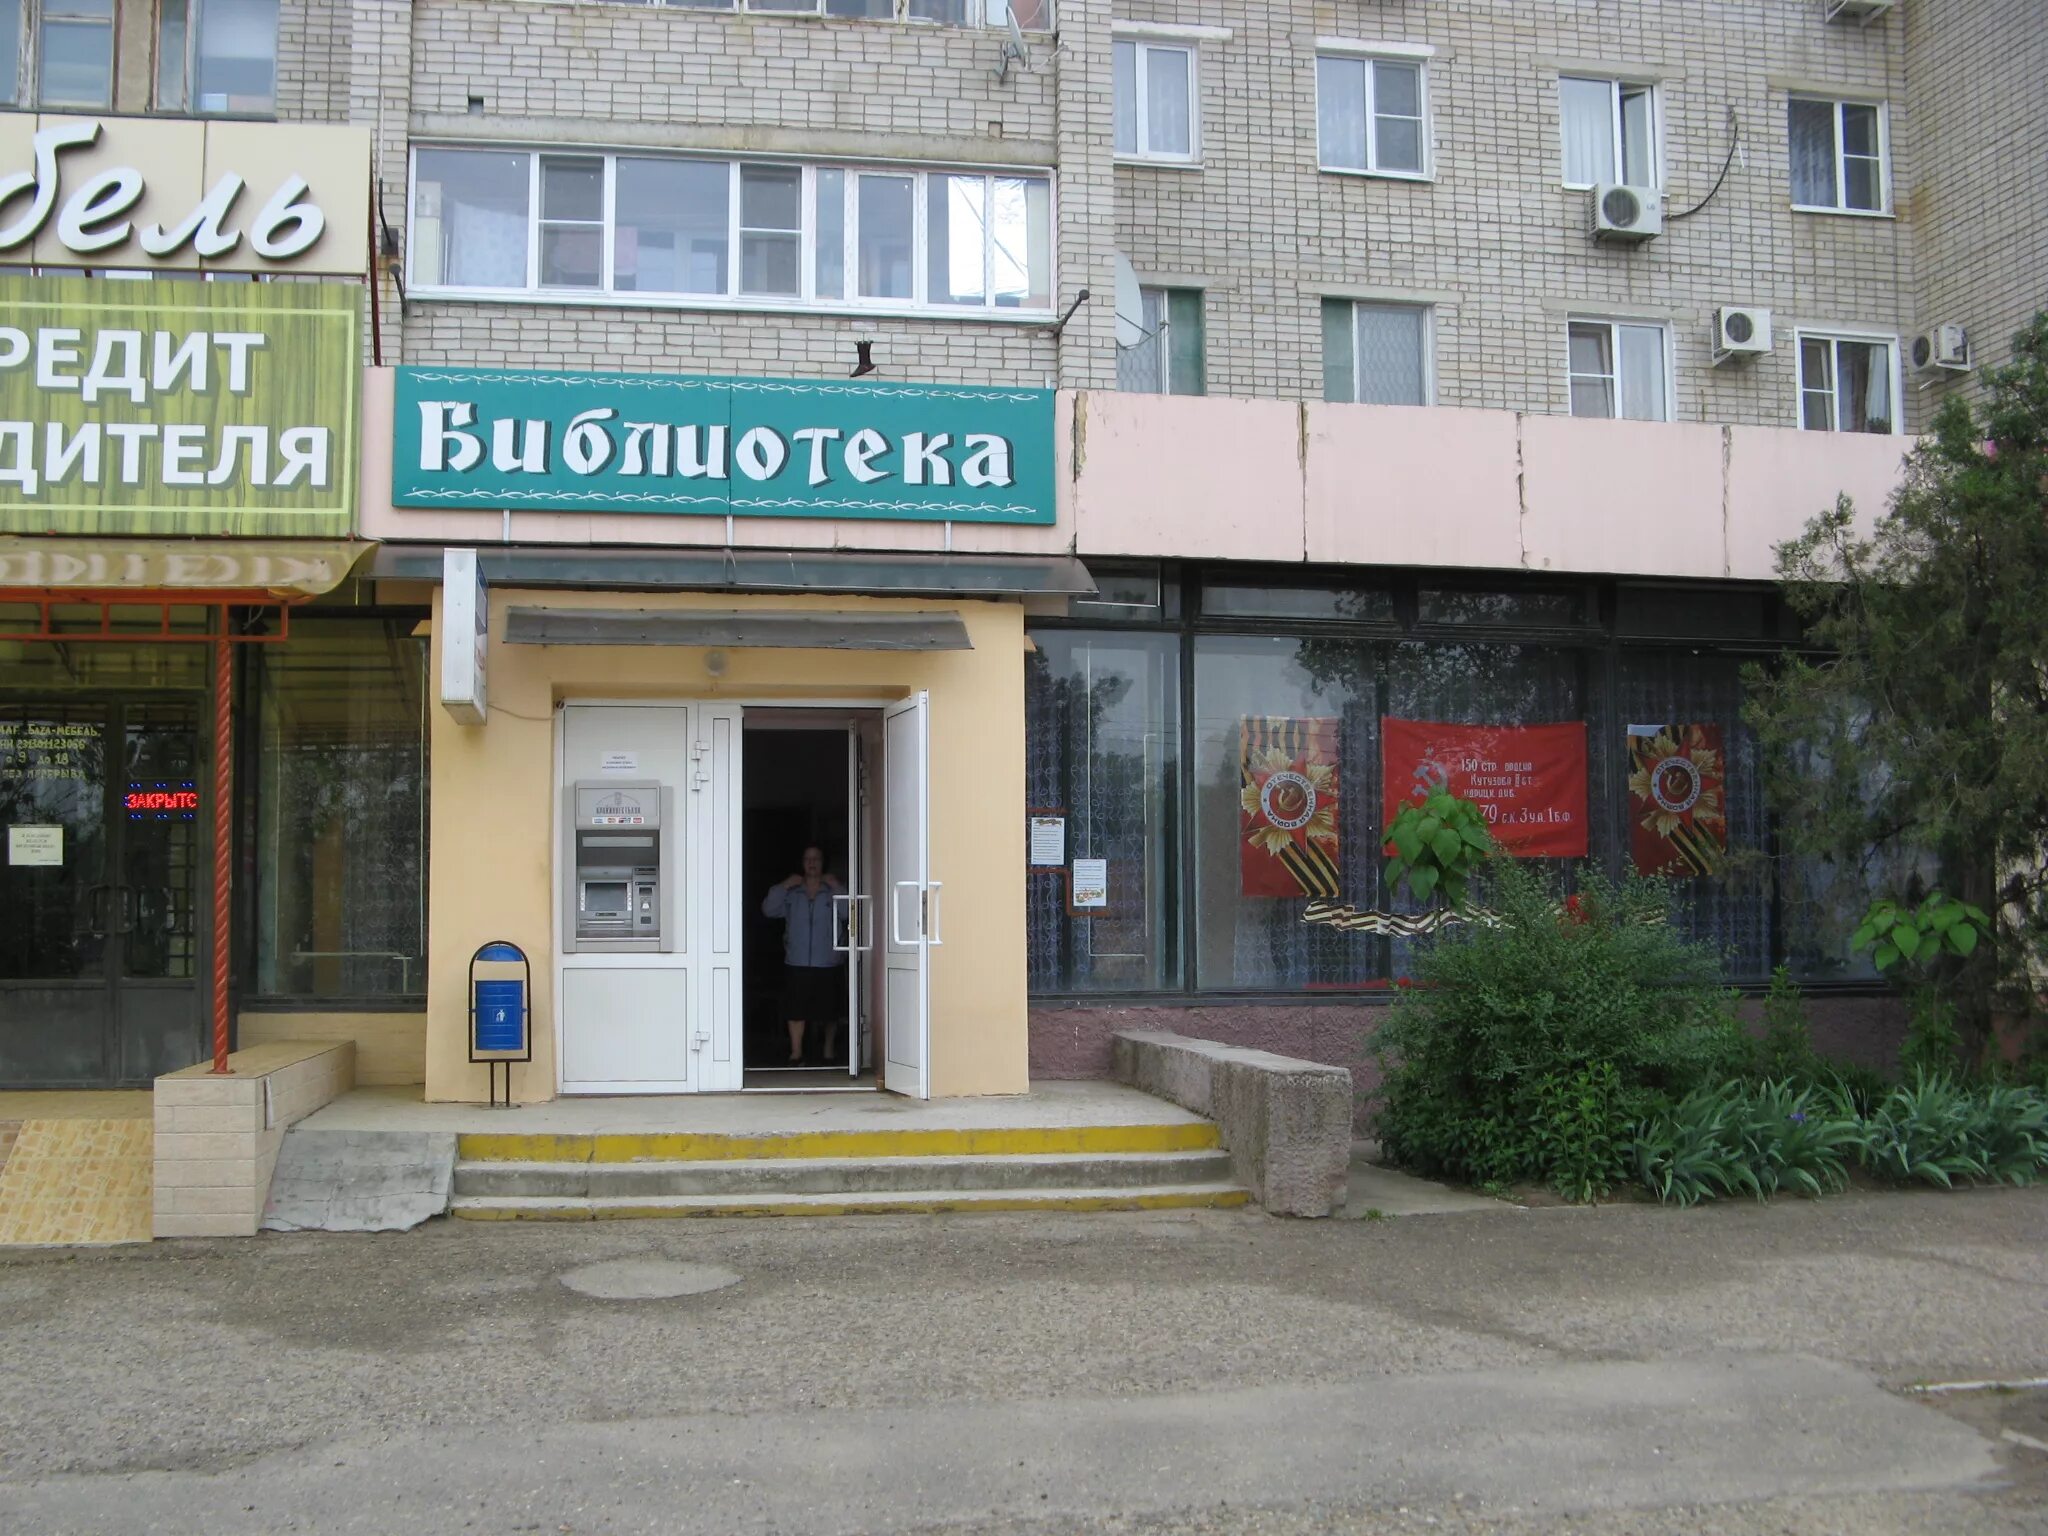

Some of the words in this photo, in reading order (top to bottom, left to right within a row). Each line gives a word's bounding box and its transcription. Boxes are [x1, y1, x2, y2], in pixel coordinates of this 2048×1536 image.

[416, 399, 1018, 489] Библиотека
[18, 751, 26, 763] 9
[56, 752, 69, 765] 18
[1460, 758, 1478, 772] 150
[1480, 803, 1498, 824] 79
